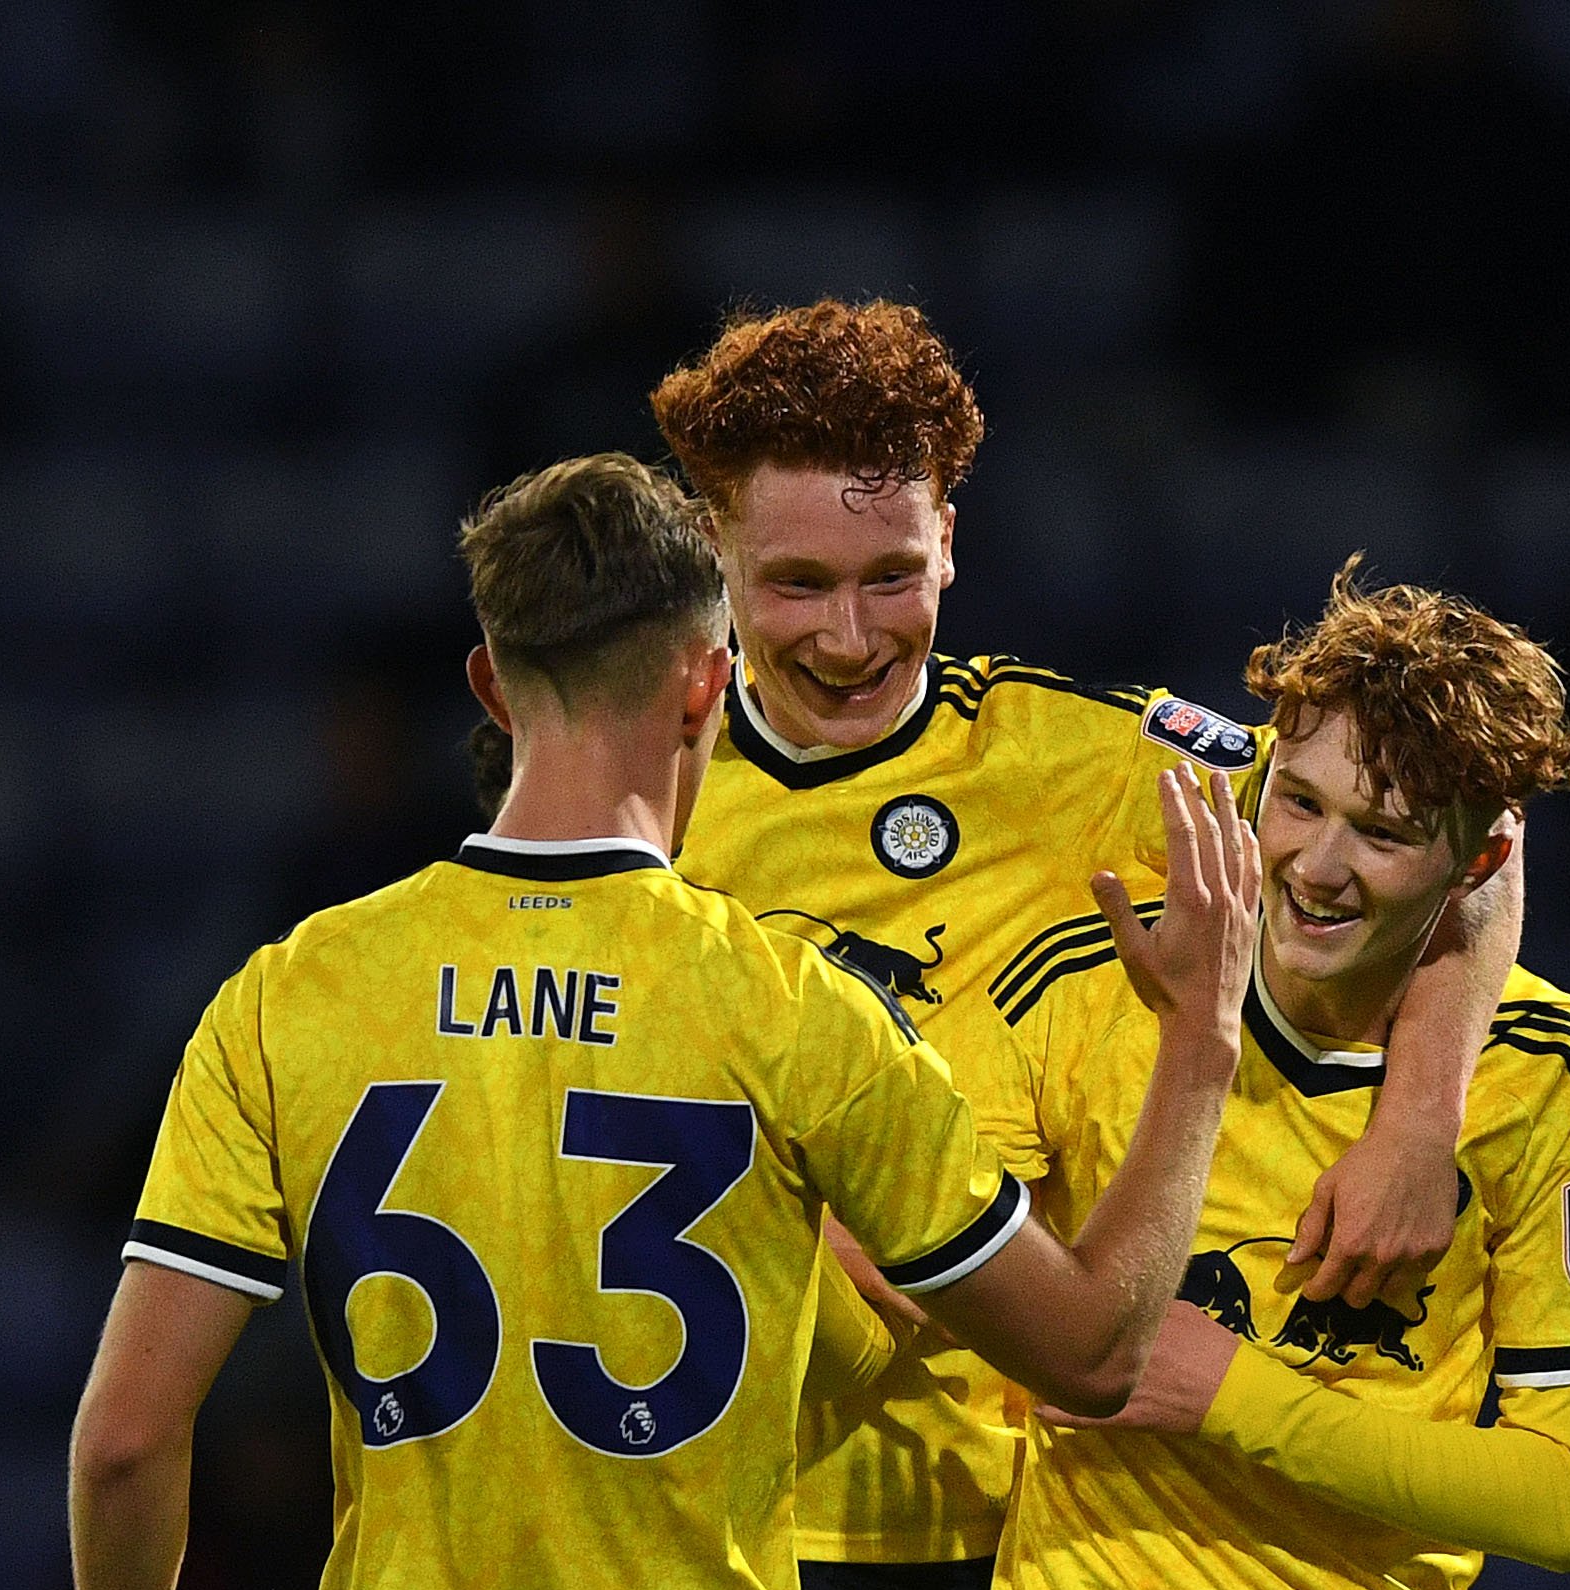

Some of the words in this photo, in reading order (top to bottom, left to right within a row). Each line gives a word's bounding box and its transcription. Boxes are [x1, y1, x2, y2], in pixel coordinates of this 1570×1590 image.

[890, 813, 910, 849] LEEDS
[905, 849, 928, 860] AFC
[508, 895, 573, 910] LEEDS
[436, 964, 622, 1047] LANE
[303, 1080, 757, 1459] 63
